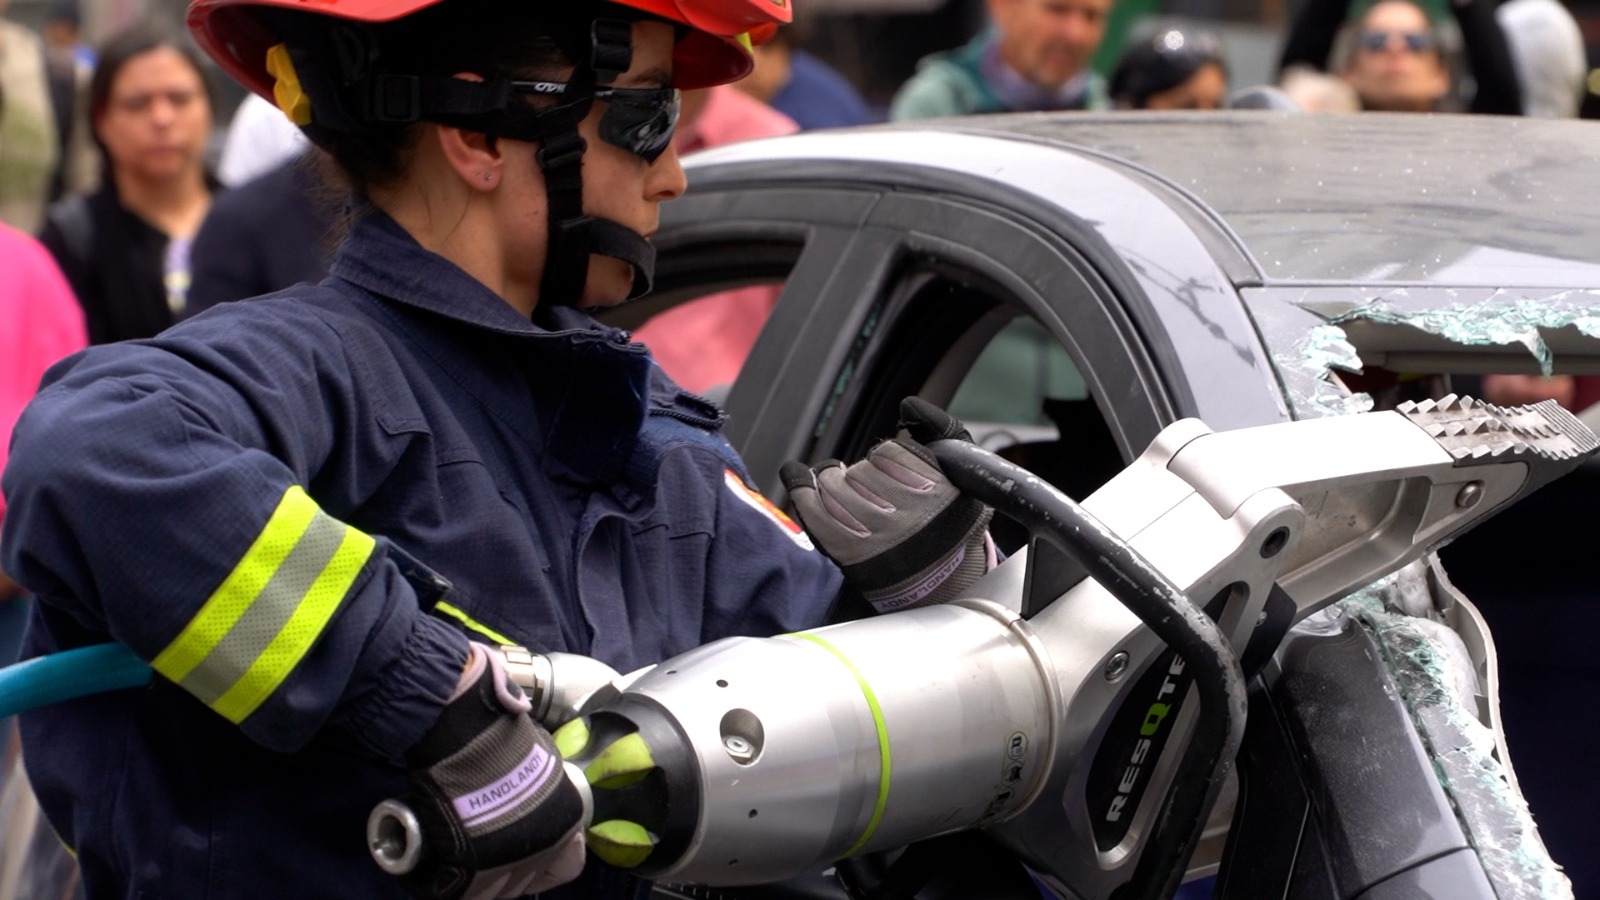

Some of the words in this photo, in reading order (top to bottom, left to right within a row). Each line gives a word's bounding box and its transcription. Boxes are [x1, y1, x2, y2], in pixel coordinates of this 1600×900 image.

[880, 557, 960, 609] HANDLANDY
[1106, 654, 1186, 822] RESQTE
[469, 751, 542, 810] HANDLANDY
